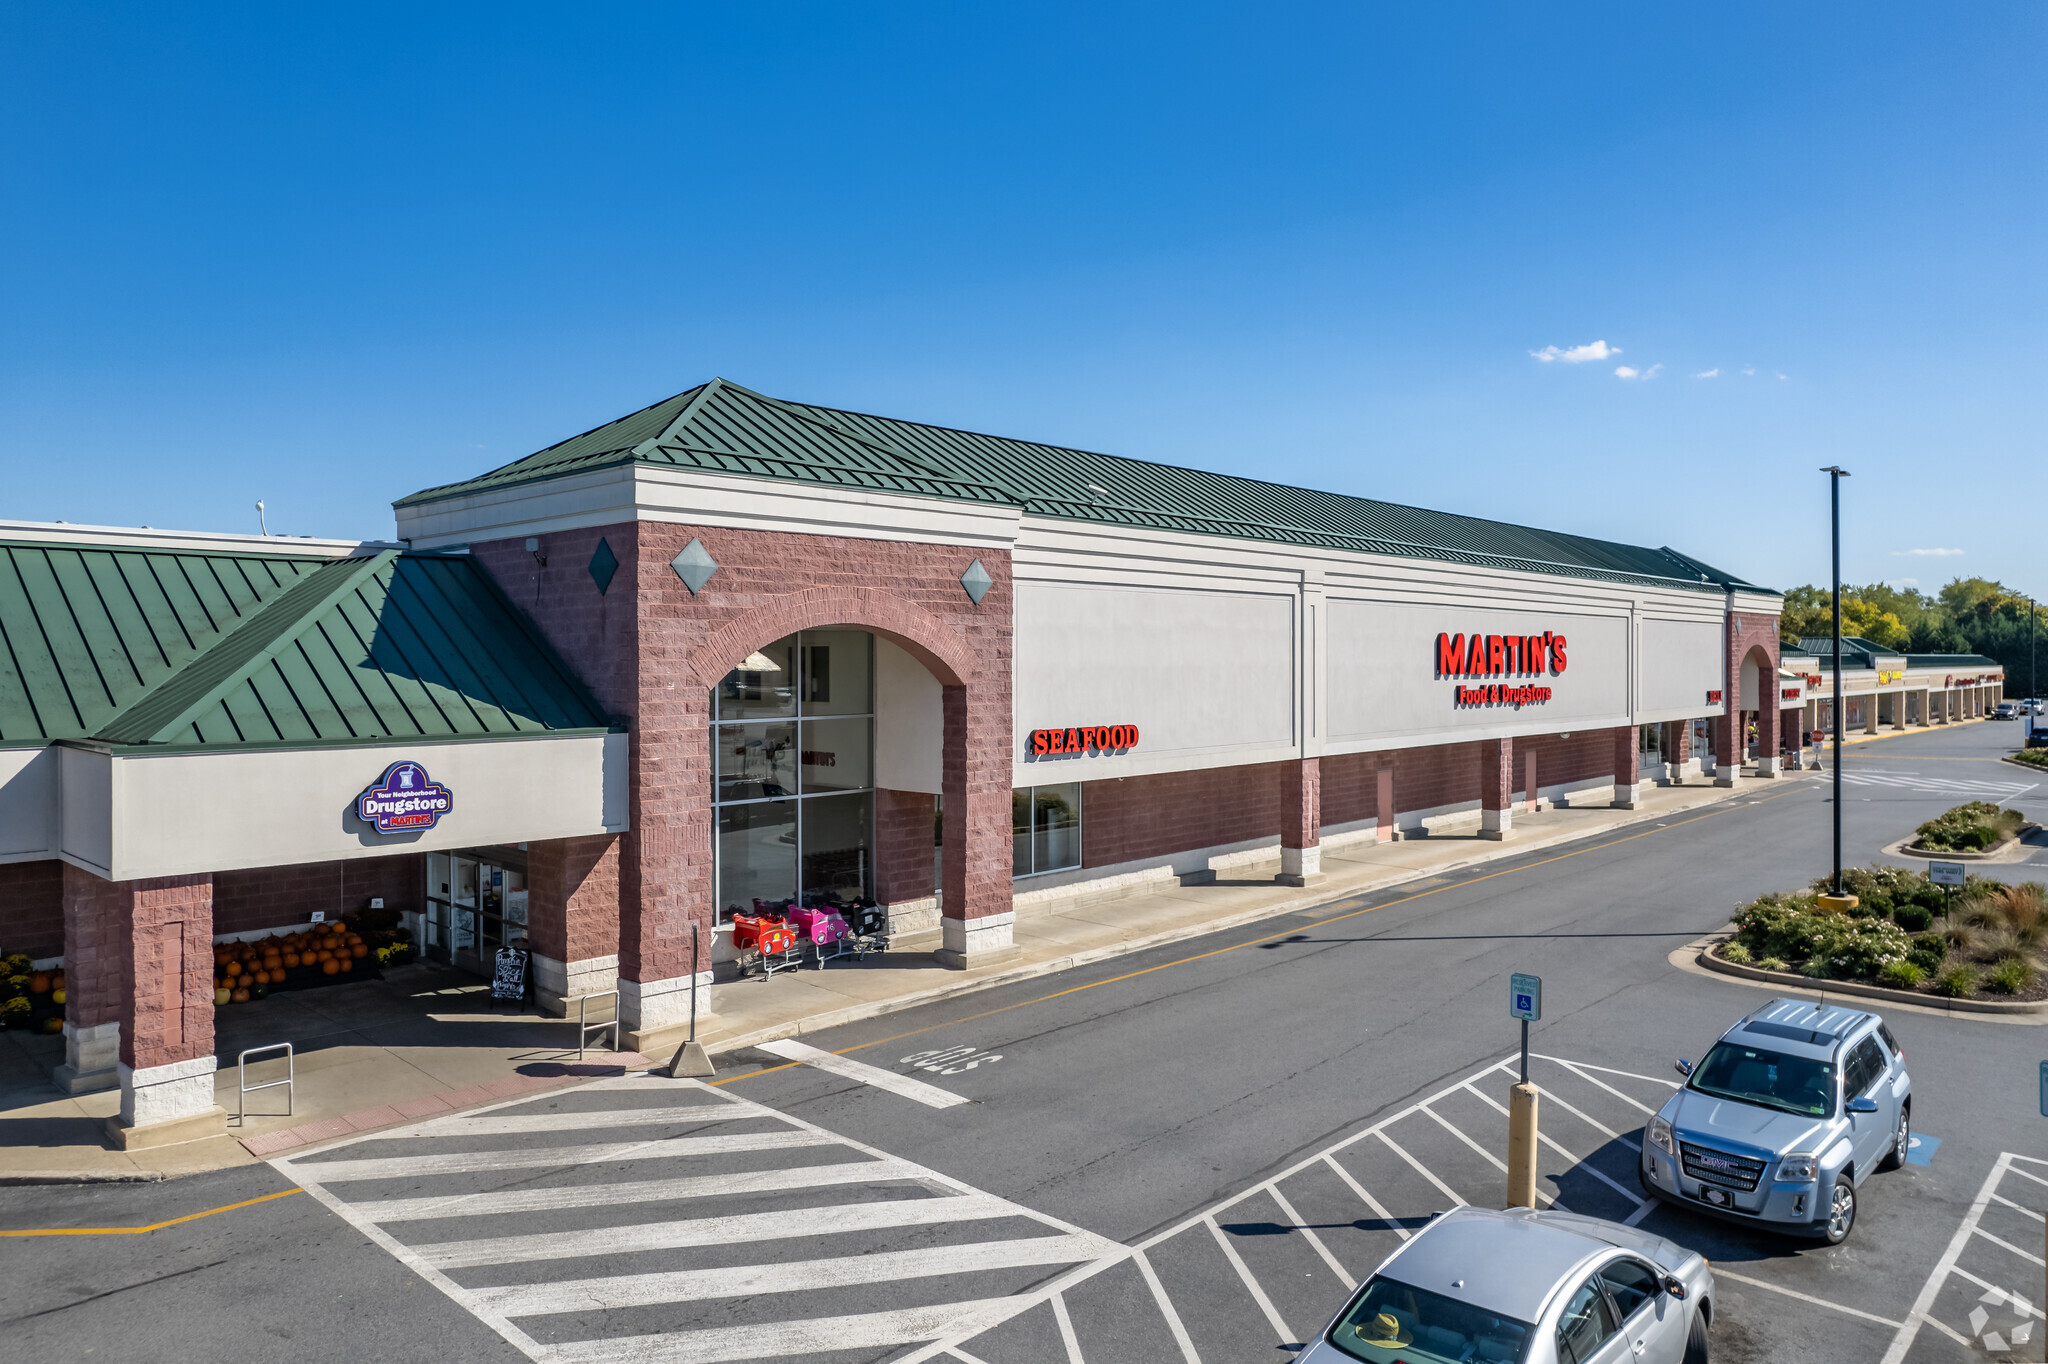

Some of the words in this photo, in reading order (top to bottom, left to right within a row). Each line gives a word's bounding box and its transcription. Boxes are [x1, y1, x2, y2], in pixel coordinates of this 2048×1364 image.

[1438, 631, 1567, 675] MARTIN'S
[1457, 685, 1488, 704] Food
[1489, 684, 1499, 703] &
[1501, 684, 1552, 706] Drugstore
[1032, 724, 1139, 755] SEAFOOD
[392, 789, 437, 799] Neighborhood
[366, 797, 447, 815] Drugstore
[390, 813, 431, 826] MARTIN'S
[1701, 1154, 1739, 1169] GMC
